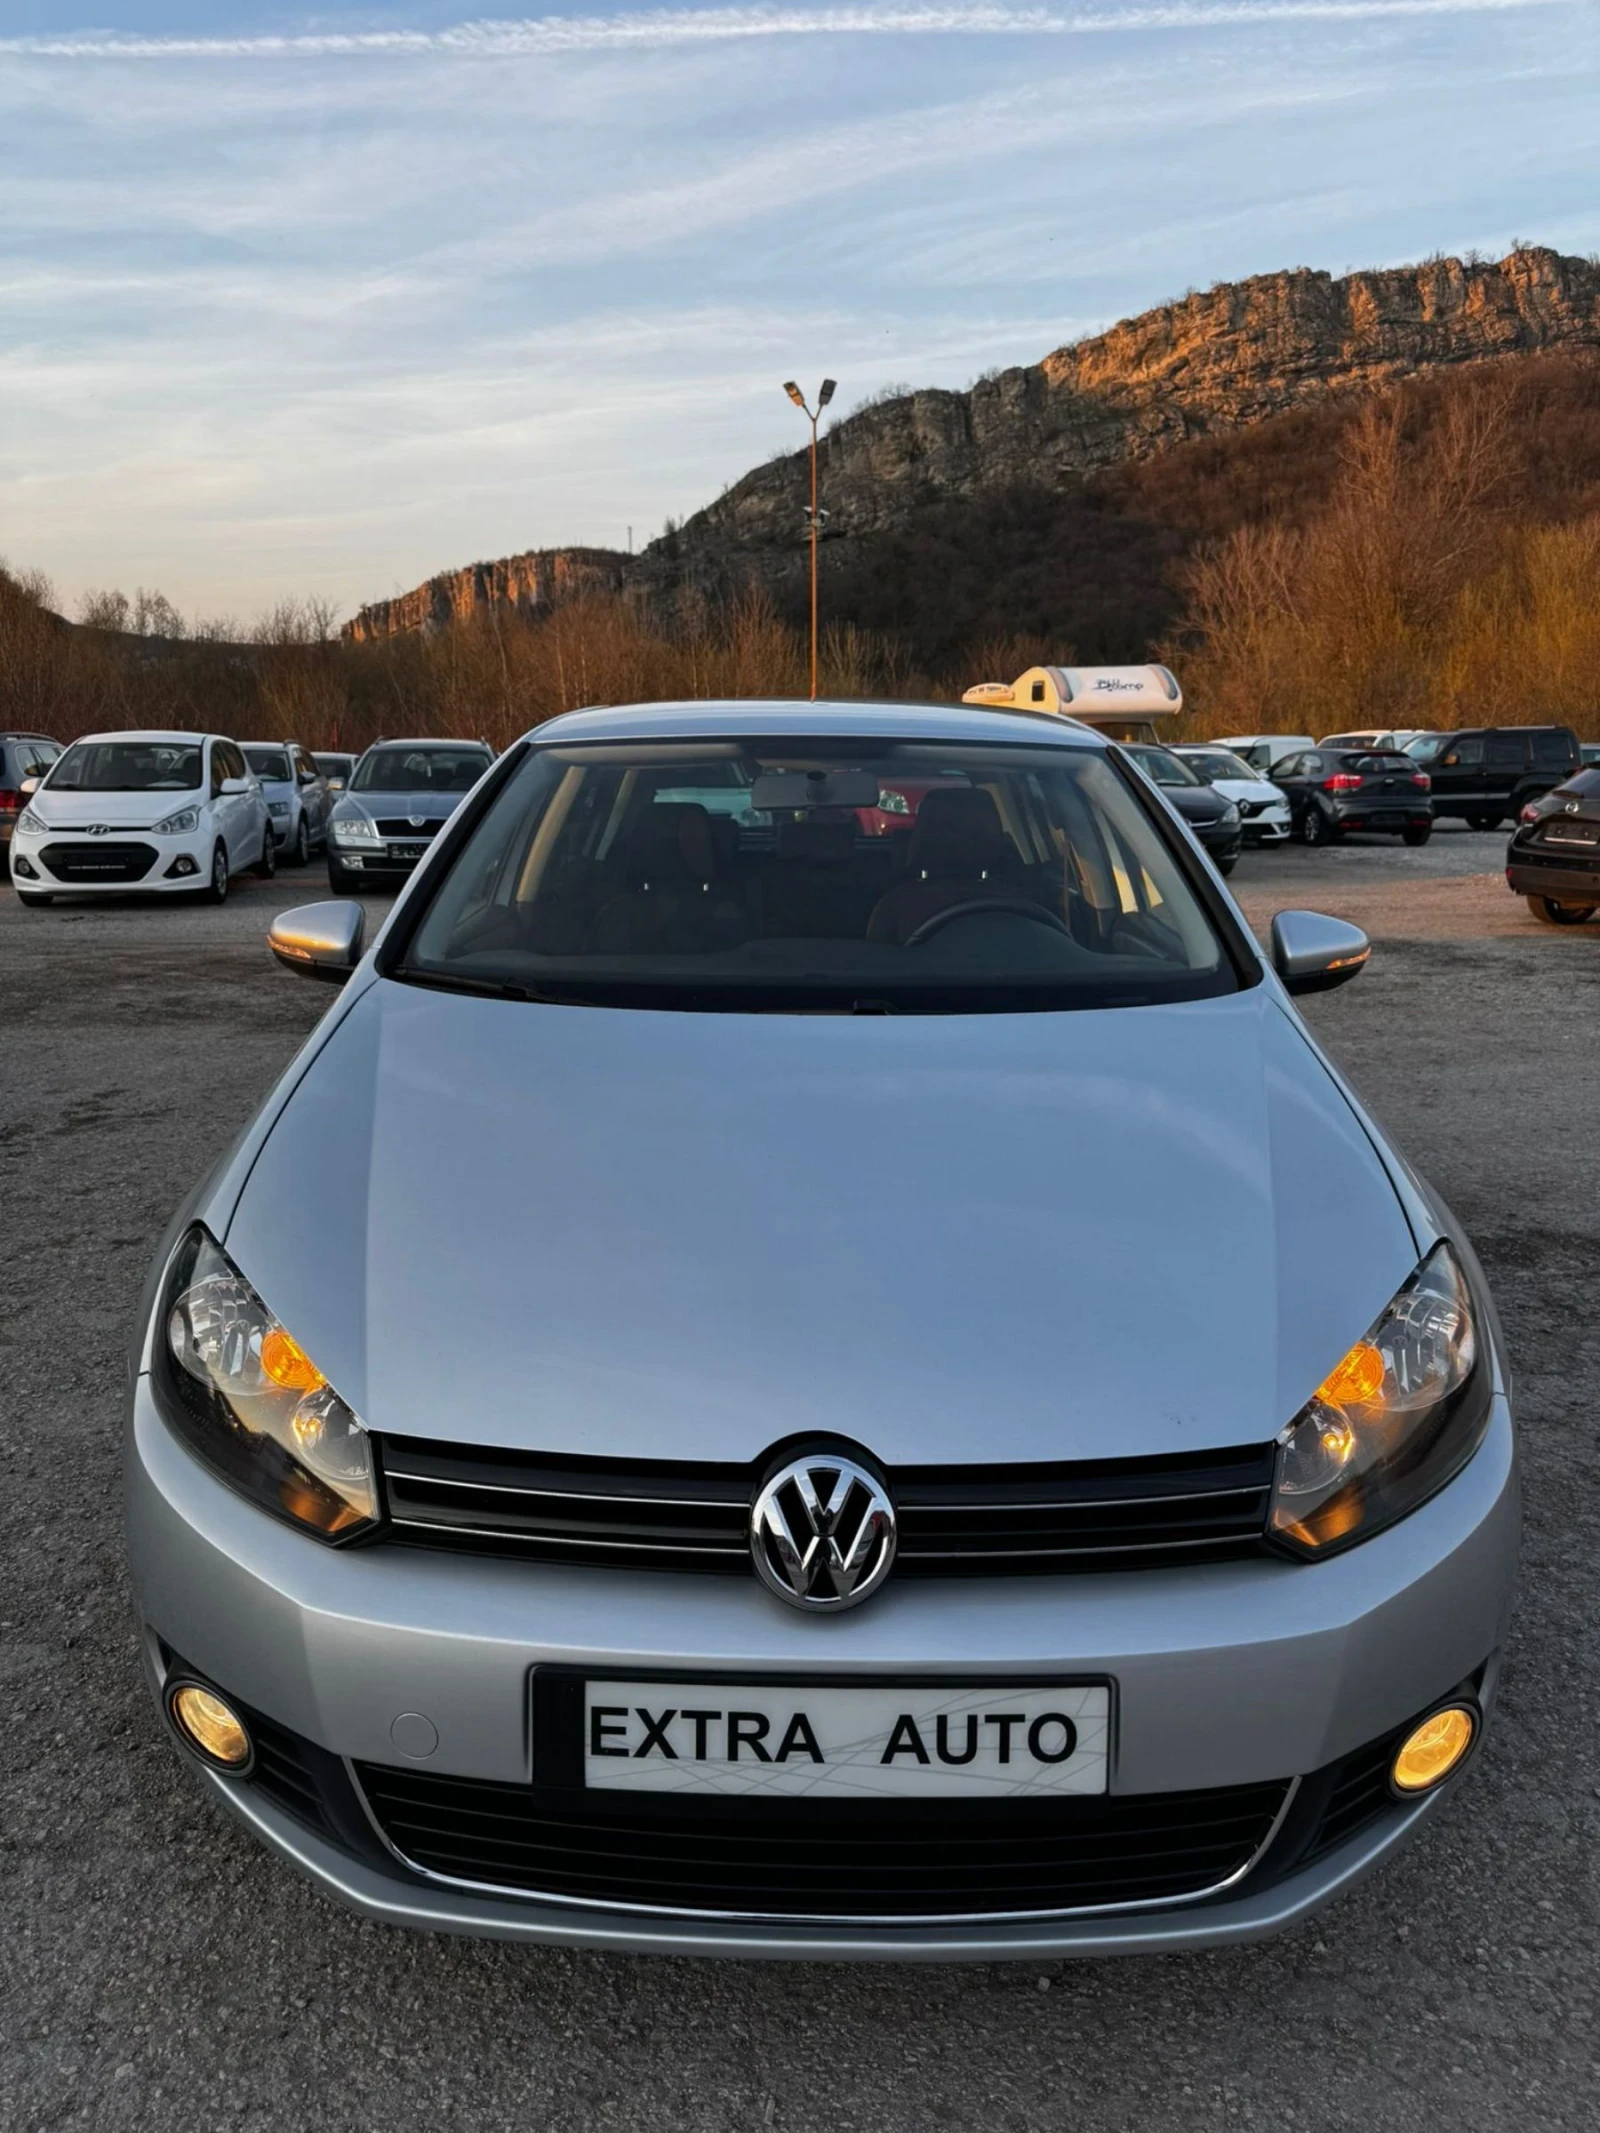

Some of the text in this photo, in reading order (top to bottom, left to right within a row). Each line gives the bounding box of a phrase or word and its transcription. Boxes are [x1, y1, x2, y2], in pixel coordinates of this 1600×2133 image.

[757, 1461, 891, 1604] VW
[590, 1705, 1078, 1766] EXTRA AUTO
